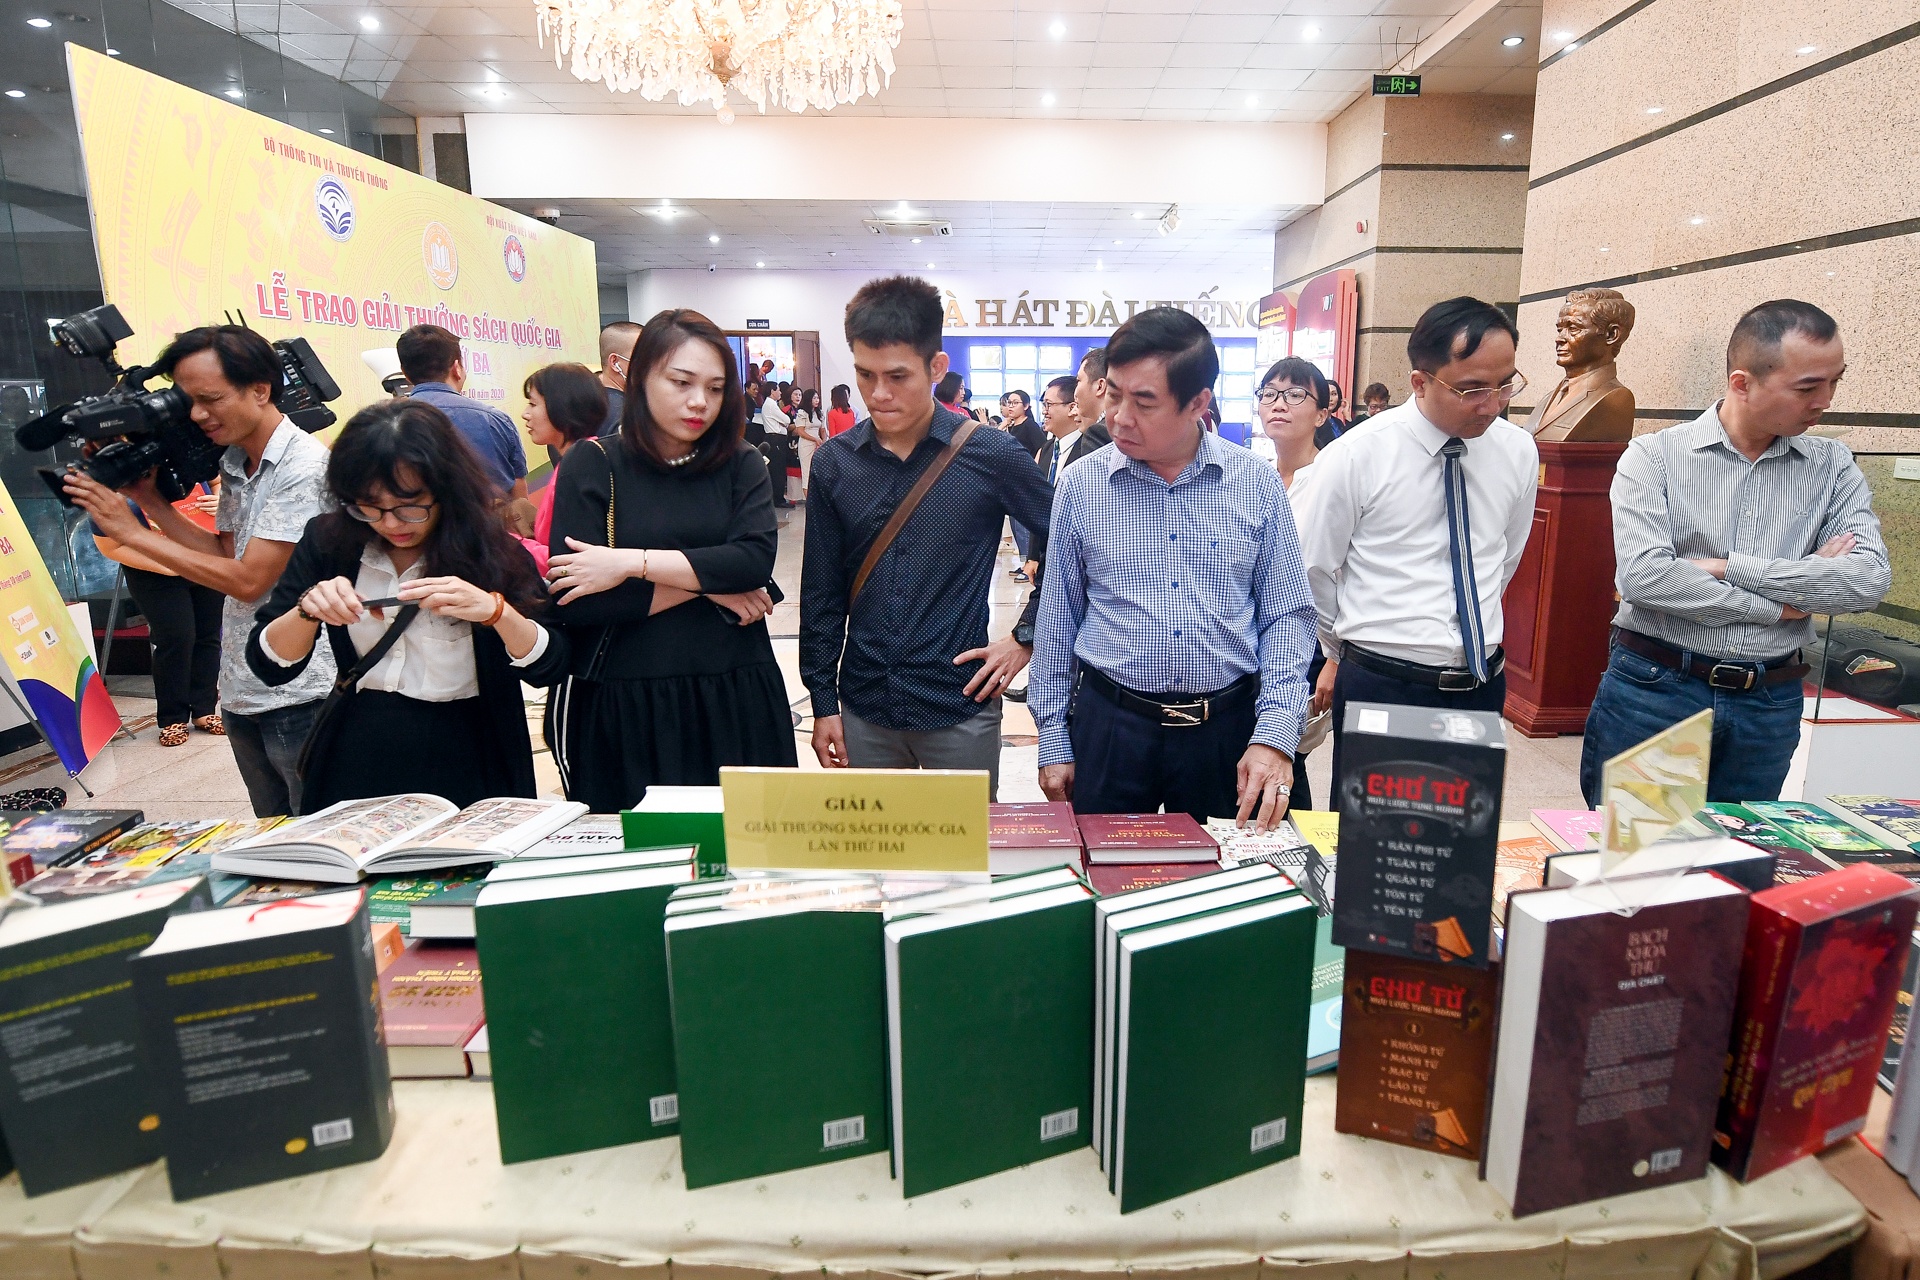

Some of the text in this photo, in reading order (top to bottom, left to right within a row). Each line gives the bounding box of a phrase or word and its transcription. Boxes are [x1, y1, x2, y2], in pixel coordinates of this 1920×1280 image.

[263, 137, 276, 156] BỘ
[278, 142, 307, 163] THÔNG
[308, 152, 322, 169] TIN
[323, 157, 334, 173] VÀ
[366, 172, 389, 190] THÔNG
[255, 271, 562, 349] LỄ TRAO GIẢI THƯỞNG SÁCH QUỐC GIA
[975, 289, 1060, 327] HÁT
[1065, 289, 1140, 327] ĐÀI
[472, 351, 491, 374] BA
[1367, 773, 1427, 800] CHƯ
[825, 794, 884, 812] GIẢI A
[939, 822, 967, 836] GIA
[878, 841, 905, 853] HAI
[1370, 976, 1427, 1003] CHƯ
